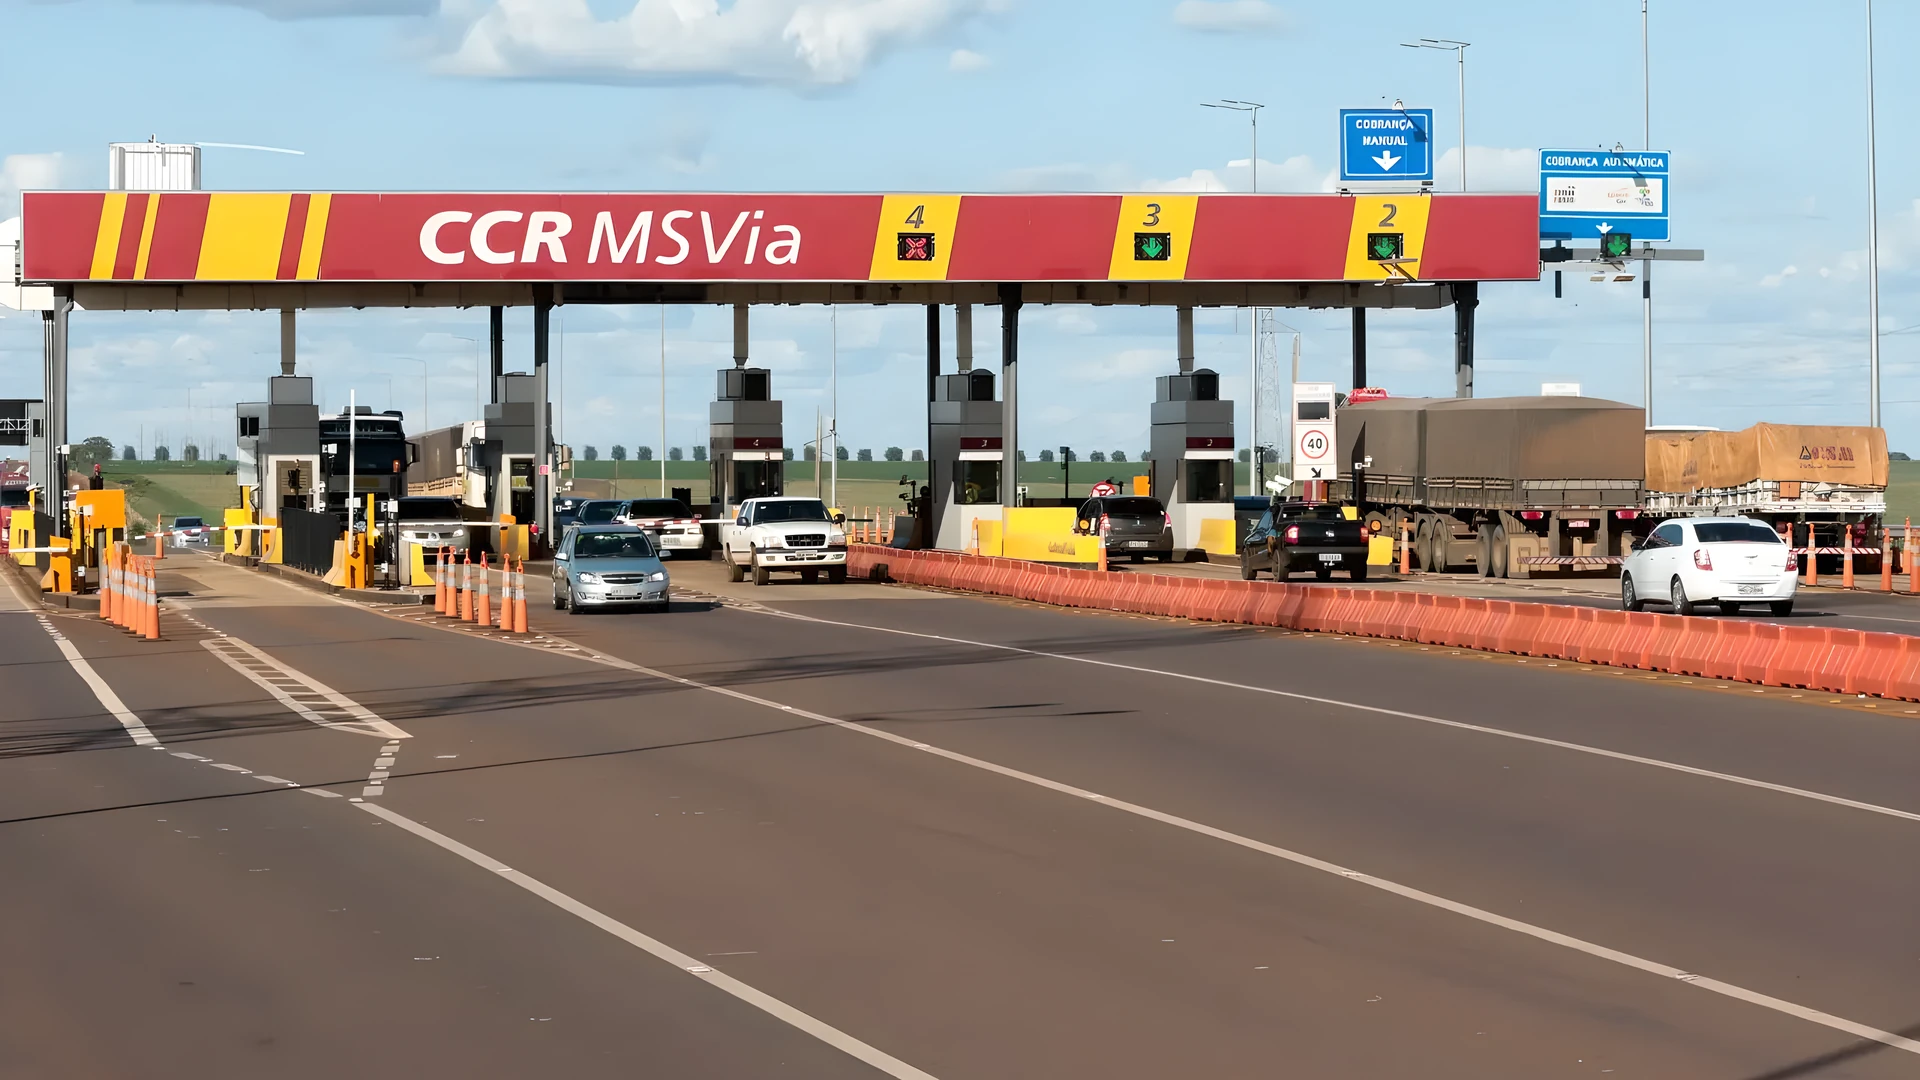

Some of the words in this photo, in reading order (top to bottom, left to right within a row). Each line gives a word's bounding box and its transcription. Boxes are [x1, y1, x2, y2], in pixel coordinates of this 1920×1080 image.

[1355, 119, 1414, 131] COBRANÇA
[1362, 135, 1408, 146] MANUAL
[1545, 156, 1599, 168] COBRANÇA
[904, 204, 925, 229] 4
[1142, 203, 1161, 227] 3
[1378, 203, 1397, 227] 2
[419, 210, 573, 265] CCR
[587, 209, 802, 266] MSVia
[1307, 438, 1323, 449] 40
